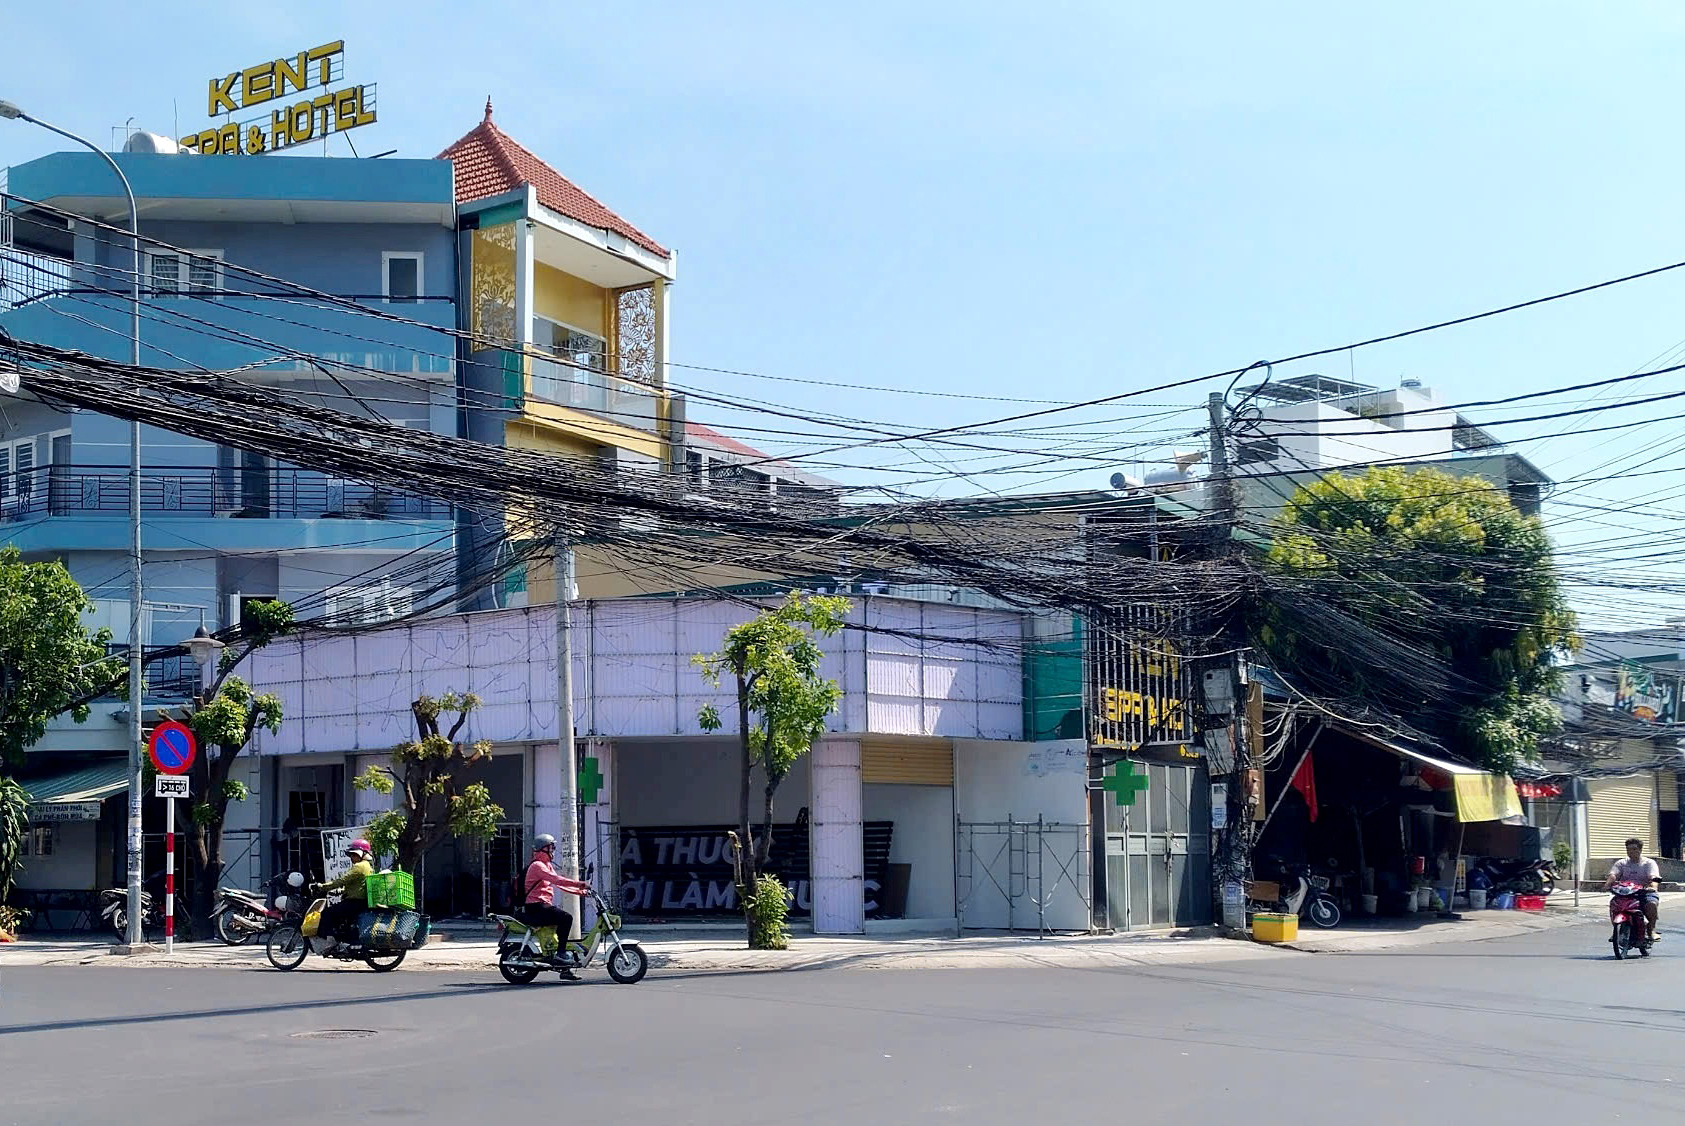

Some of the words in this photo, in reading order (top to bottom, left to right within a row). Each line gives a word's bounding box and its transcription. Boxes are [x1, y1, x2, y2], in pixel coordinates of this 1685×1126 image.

[208, 40, 344, 117] KENT
[246, 125, 265, 154] &
[271, 84, 376, 150] HOTEL
